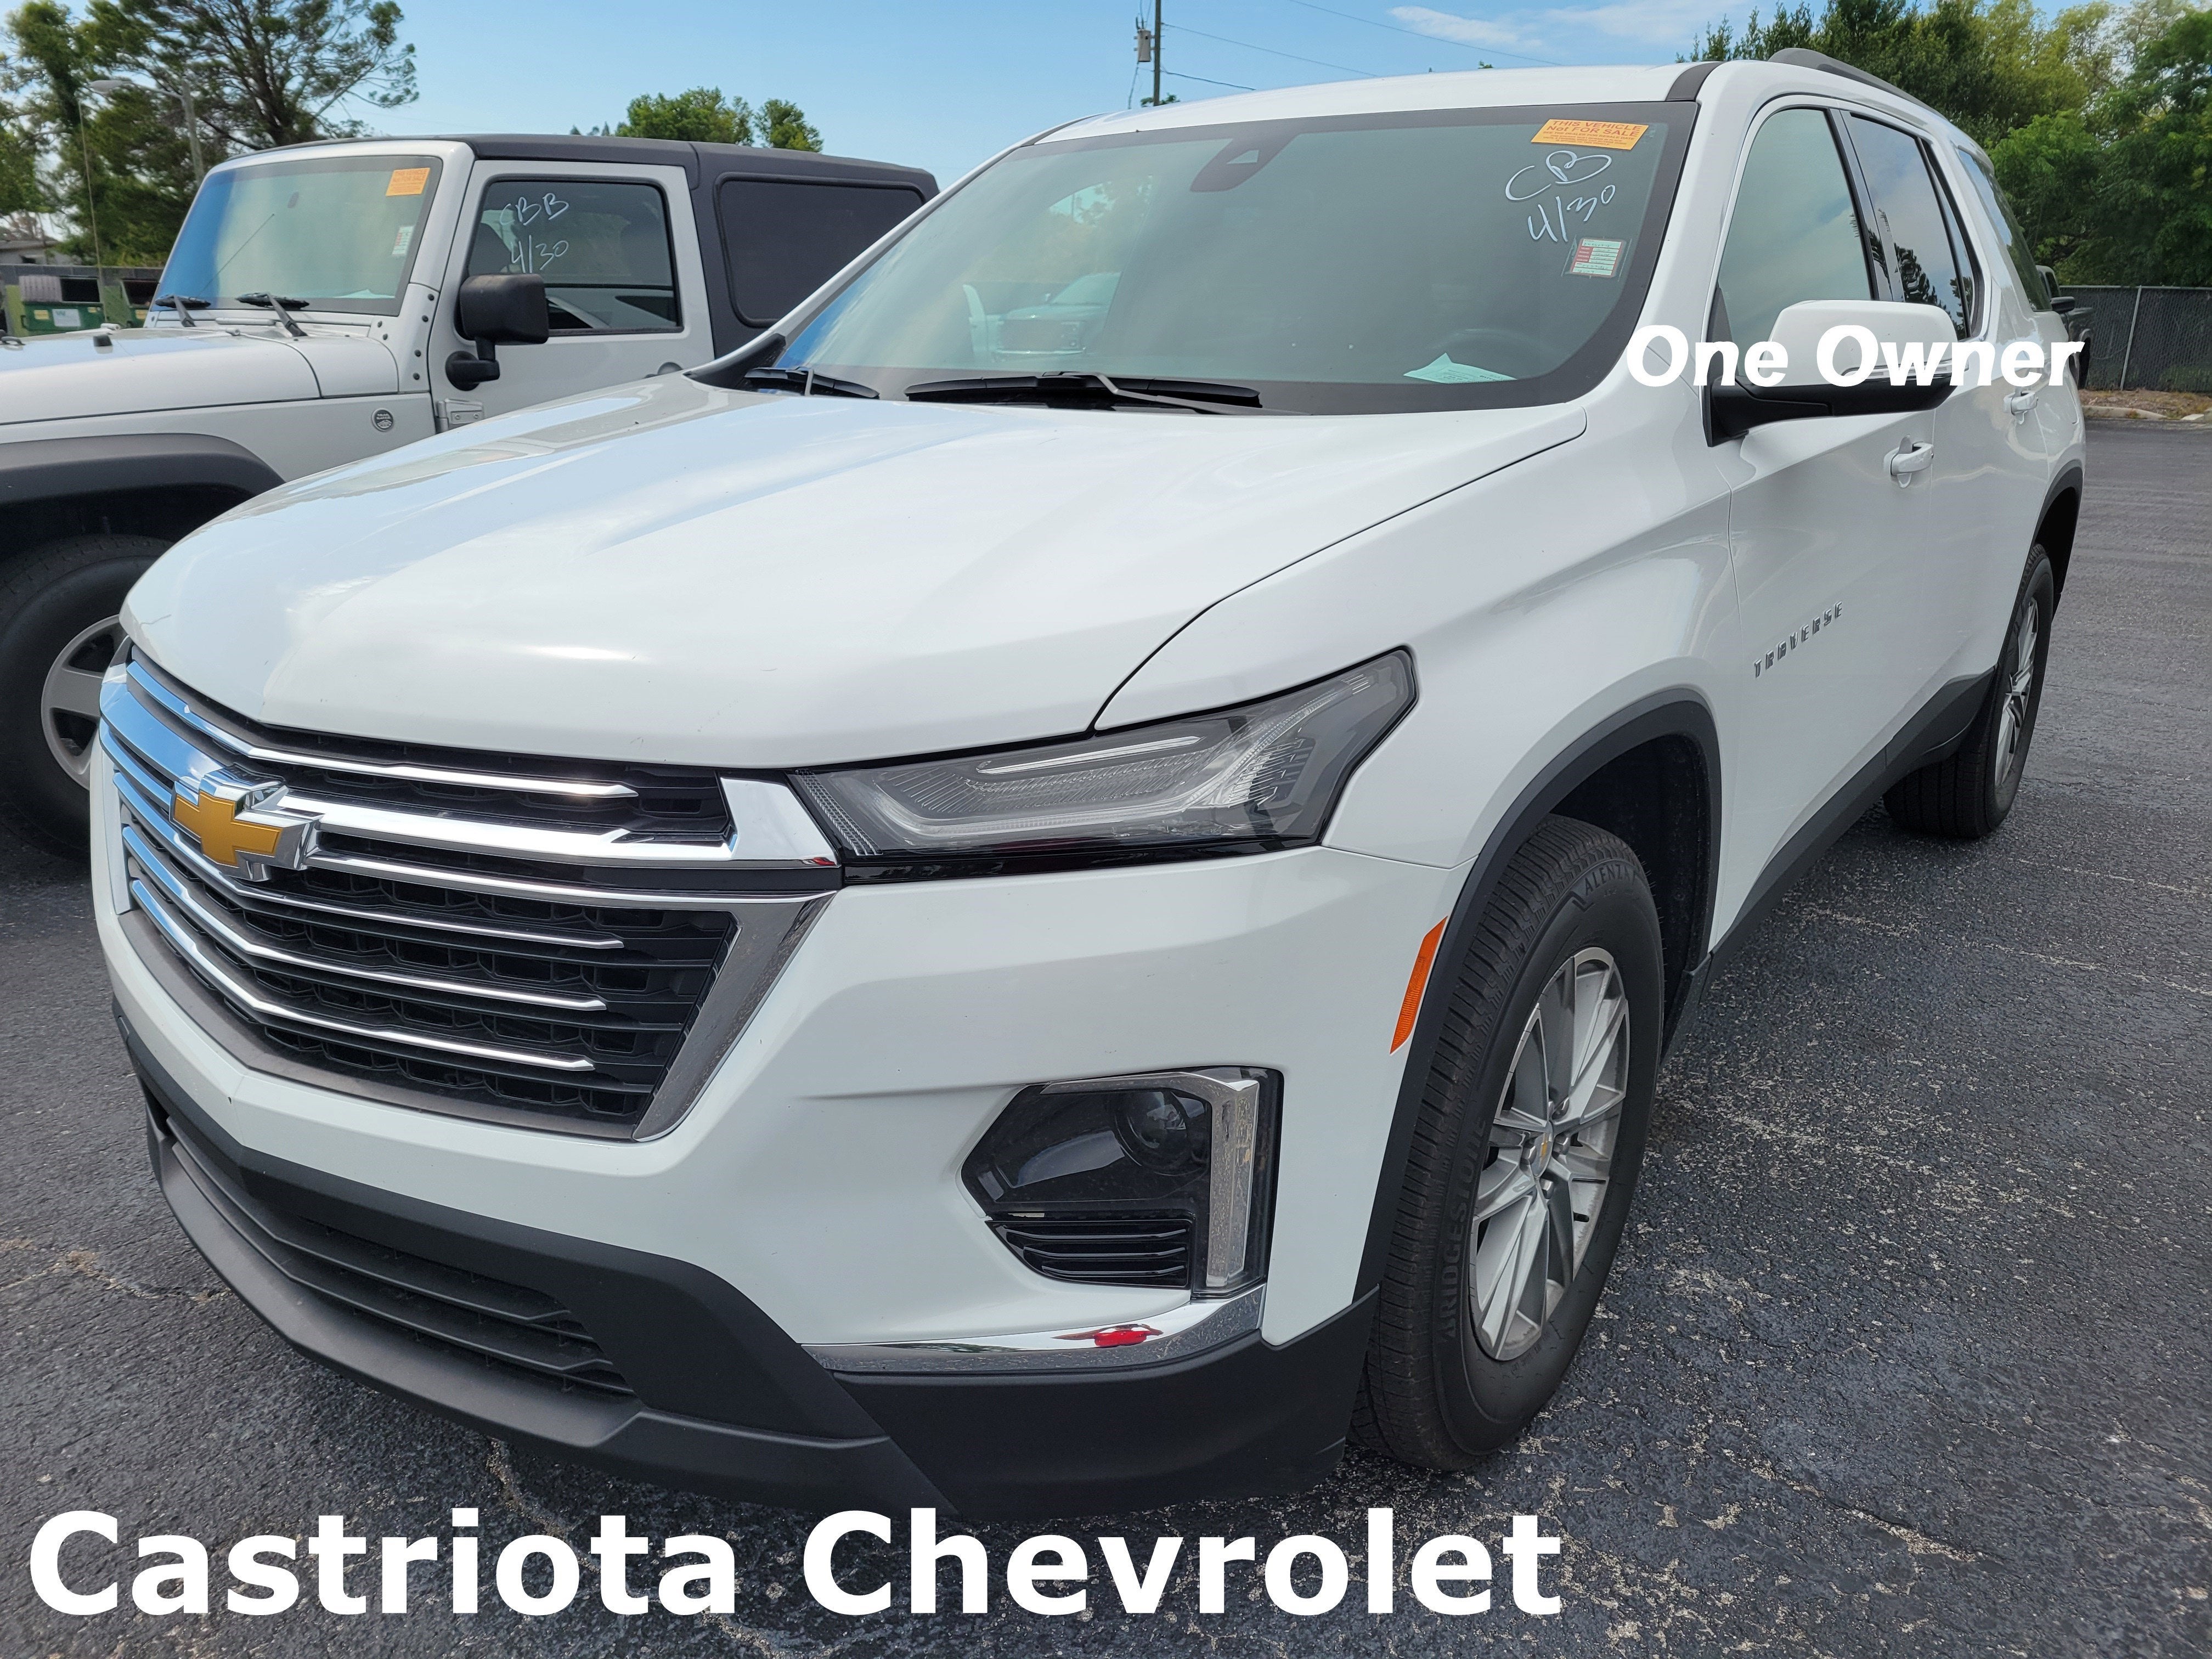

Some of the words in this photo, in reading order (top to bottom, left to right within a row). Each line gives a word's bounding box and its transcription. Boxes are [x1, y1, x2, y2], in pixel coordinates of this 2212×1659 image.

[1585, 122, 1641, 131] VEHICLE
[1527, 184, 1616, 243] 4/30
[510, 234, 569, 274] 4/30
[1753, 600, 1843, 679] TRAVERSE
